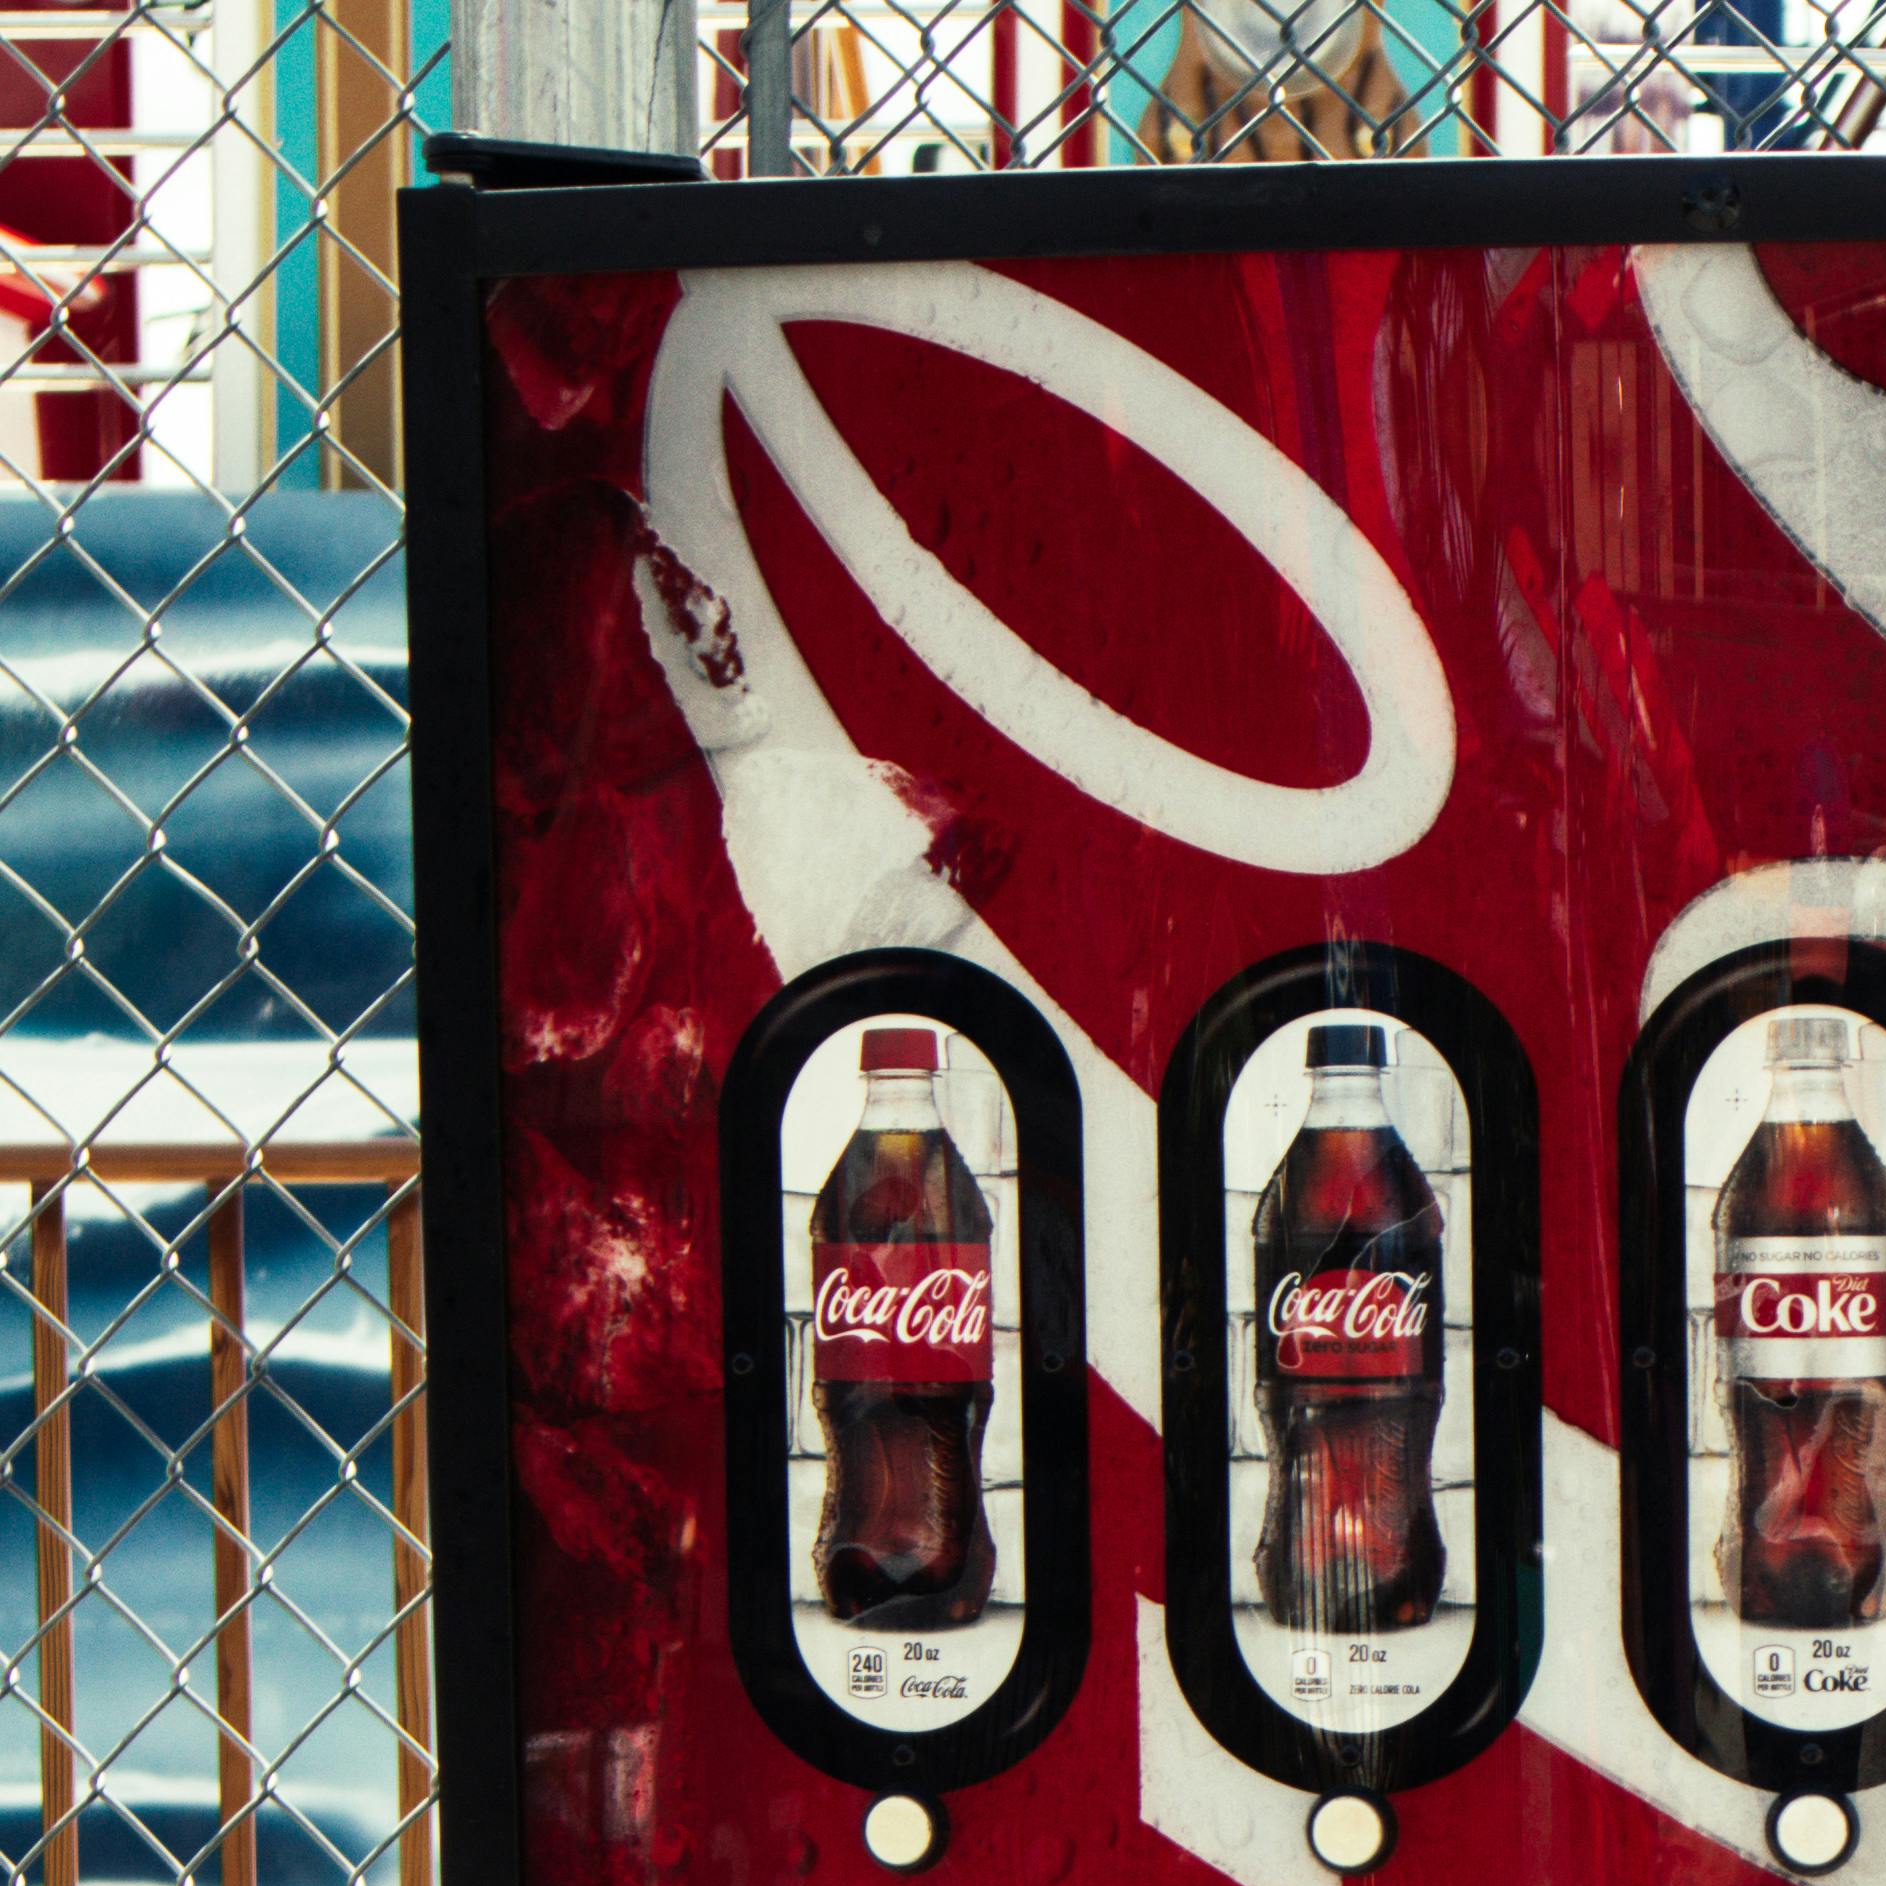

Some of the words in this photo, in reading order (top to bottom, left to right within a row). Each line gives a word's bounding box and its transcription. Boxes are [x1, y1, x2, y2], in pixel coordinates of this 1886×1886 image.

[1760, 1251, 1800, 1261] SUGAR
[1804, 1251, 1822, 1261] NO
[1825, 1250, 1880, 1261] CALORIES
[1833, 1274, 1870, 1292] Diet
[815, 1267, 990, 1344] Coca-Cola
[1268, 1271, 1432, 1338] Coca-Cola
[1740, 1278, 1877, 1333] Coke
[904, 1642, 922, 1660] 20
[926, 1648, 940, 1660] oz
[1350, 1644, 1368, 1662] 20
[1372, 1650, 1387, 1662] oz
[1812, 1640, 1832, 1658] 20
[1836, 1646, 1850, 1658] oz
[852, 1654, 882, 1673] 240
[1769, 1652, 1780, 1671] 0
[901, 1675, 967, 1698] Coca-Cola
[1804, 1669, 1869, 1692] Coke
